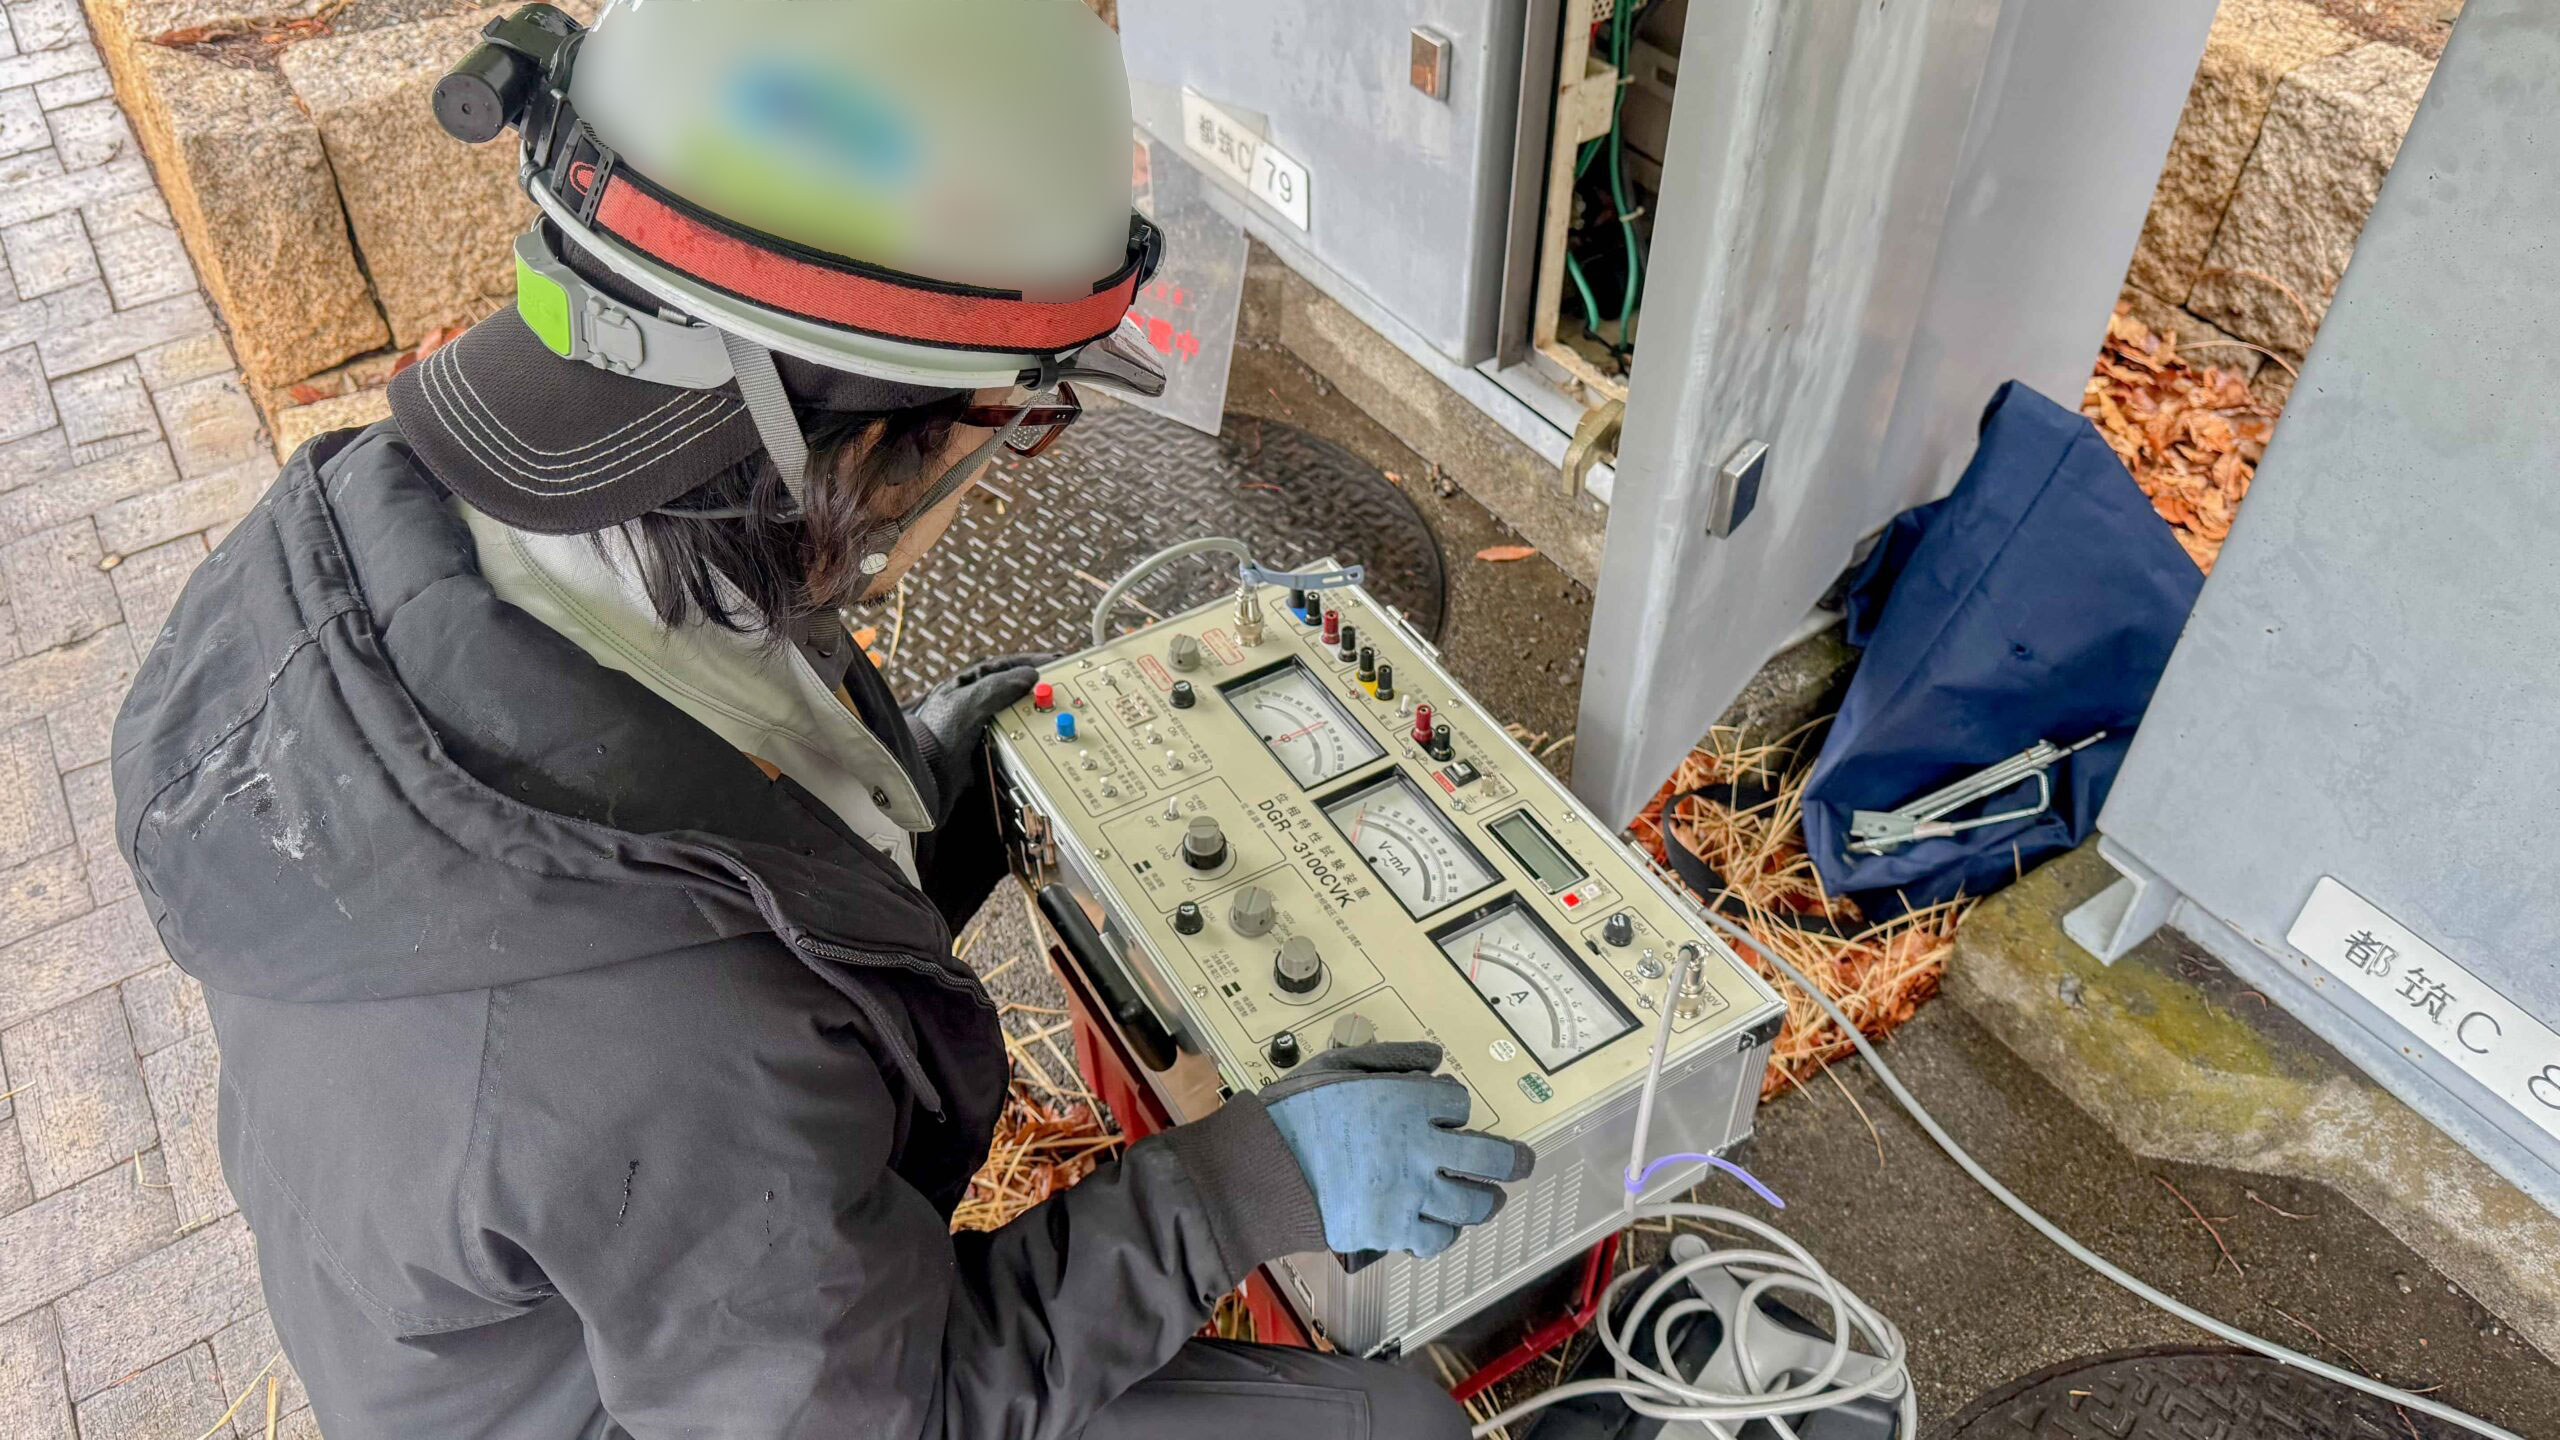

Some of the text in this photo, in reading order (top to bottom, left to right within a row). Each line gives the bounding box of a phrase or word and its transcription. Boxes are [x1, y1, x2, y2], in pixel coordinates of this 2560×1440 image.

[1263, 156, 1292, 204] 79
[1144, 815, 1159, 828] OFF
[1155, 844, 1172, 859] LEAD
[1255, 798, 1357, 909] DGR-3100CVK
[1181, 879, 1195, 892] LAG
[1623, 969, 1641, 984] OFF
[2344, 930, 2502, 1055] 都筑C
